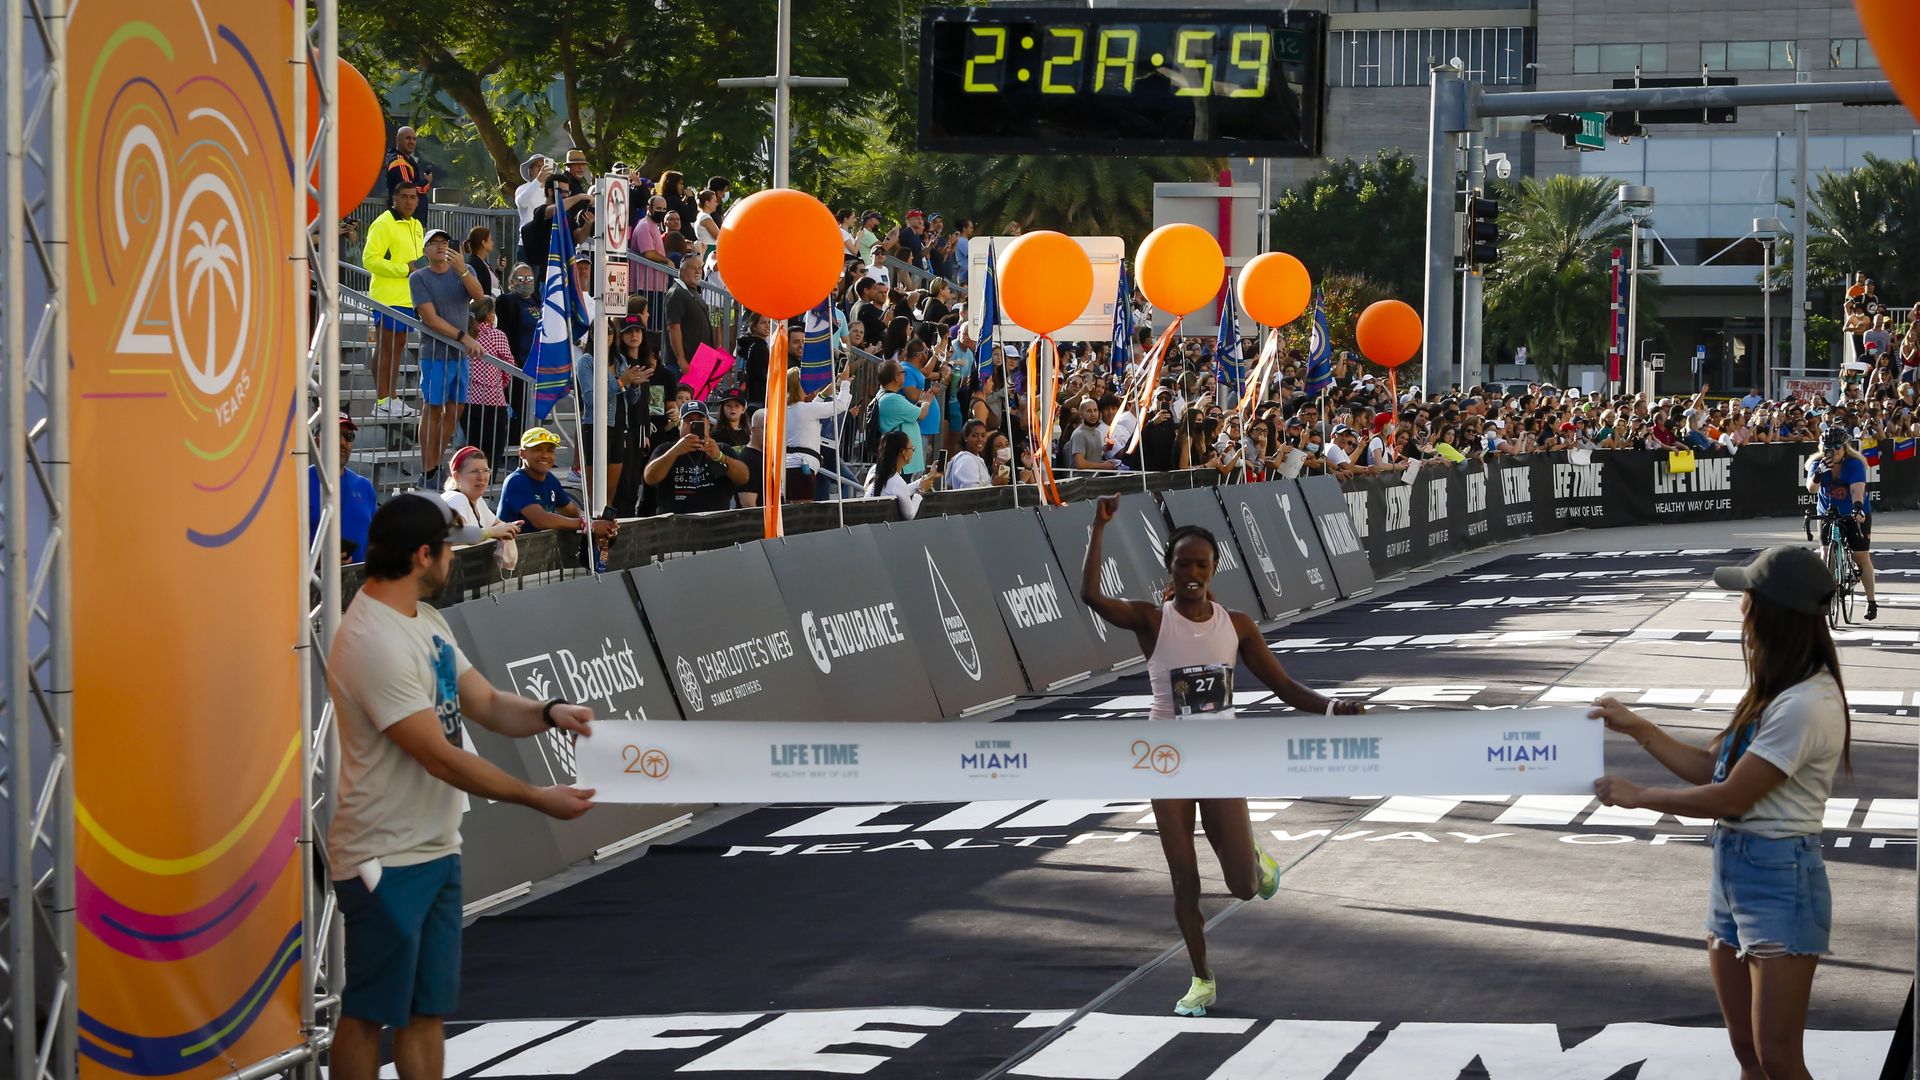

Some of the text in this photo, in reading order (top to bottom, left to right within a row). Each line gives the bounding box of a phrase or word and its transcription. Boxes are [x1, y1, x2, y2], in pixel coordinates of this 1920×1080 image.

[215, 368, 250, 428] YEARS
[1690, 458, 1731, 492] TIME
[1591, 505, 1603, 516] LIFE
[1655, 499, 1731, 513] HEALTHY WAY OF LIFE
[1003, 563, 1062, 629] verizon
[820, 602, 905, 659] ENDURANCE
[949, 629, 970, 645] SOURCE
[697, 630, 794, 685] CHARLOTTE'S WEB
[556, 637, 644, 713] Baptist
[1195, 678, 1215, 692] 27
[711, 680, 762, 707] STANLEY BROTHERS
[771, 744, 858, 765] LIFE TIME
[961, 753, 1027, 769] MIAMI
[1287, 737, 1380, 761] LIFE TIME
[1488, 745, 1557, 761] MIAMI
[1287, 764, 1380, 773] HEALTHY WAY OF LIFE
[721, 831, 1205, 857] HEALTH
[1269, 830, 1514, 844] WAY
[1559, 833, 1708, 845] OF
[322, 1006, 965, 1080] IFE
